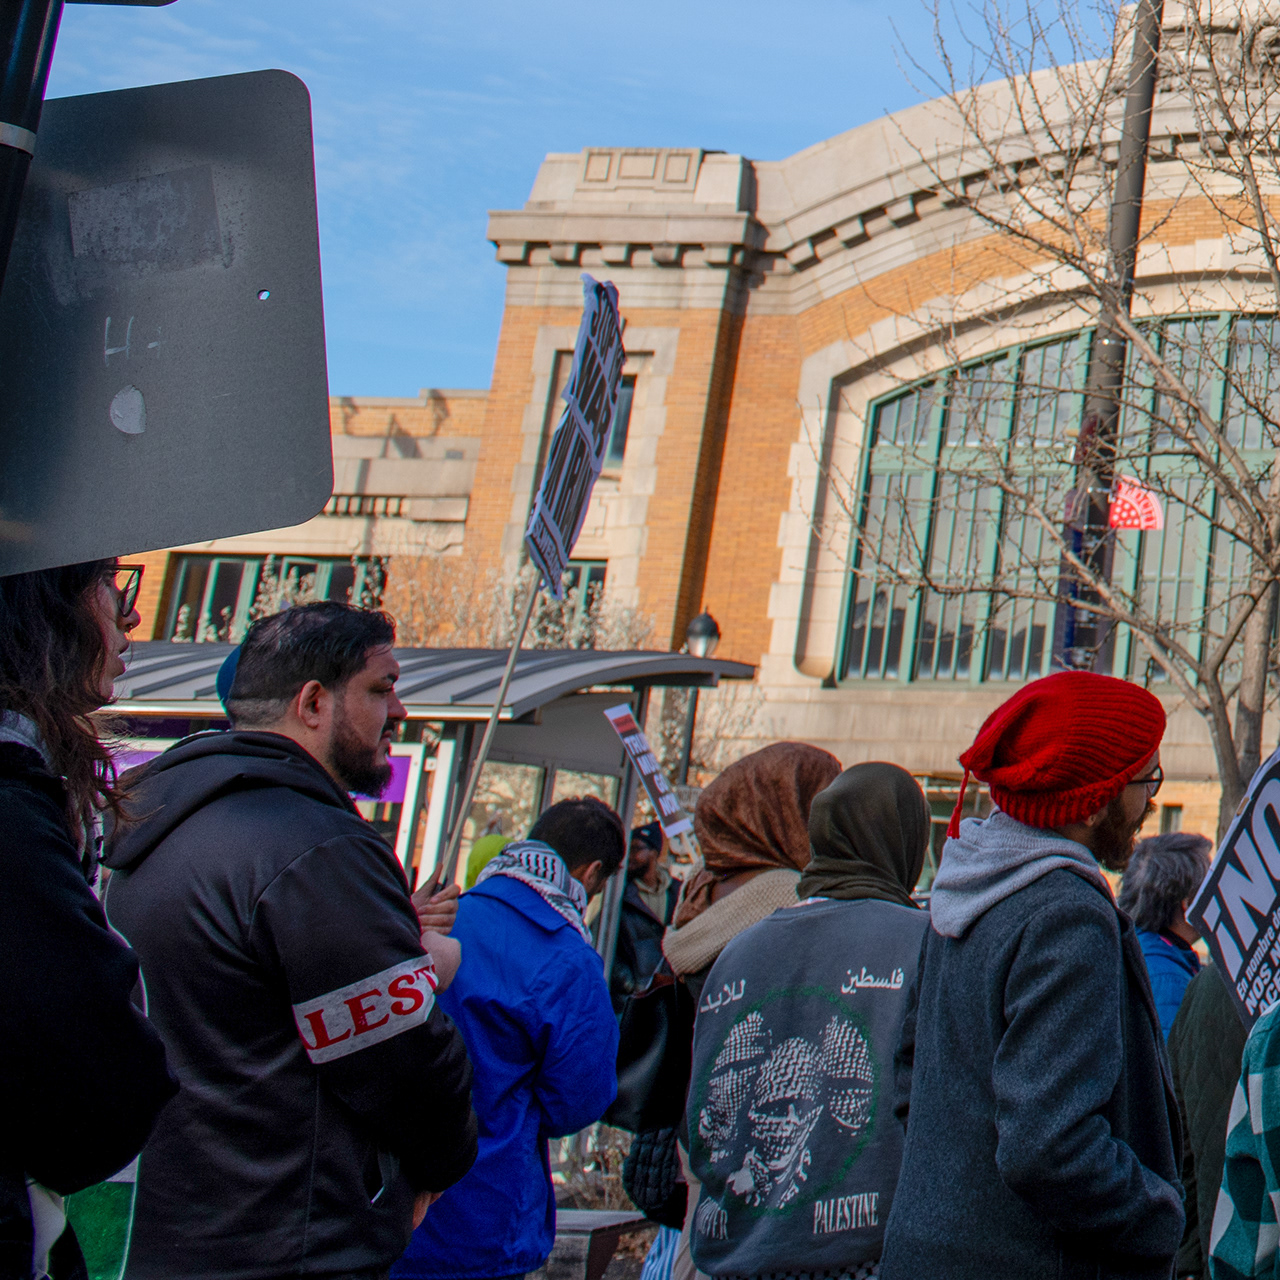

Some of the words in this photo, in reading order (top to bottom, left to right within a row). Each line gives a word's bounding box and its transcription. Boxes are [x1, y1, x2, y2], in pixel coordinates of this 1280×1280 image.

[1236, 976, 1249, 1002] En
[1245, 923, 1275, 982] nombre
[1245, 961, 1272, 1016] NOS
[812, 1191, 880, 1235] PALESTINE
